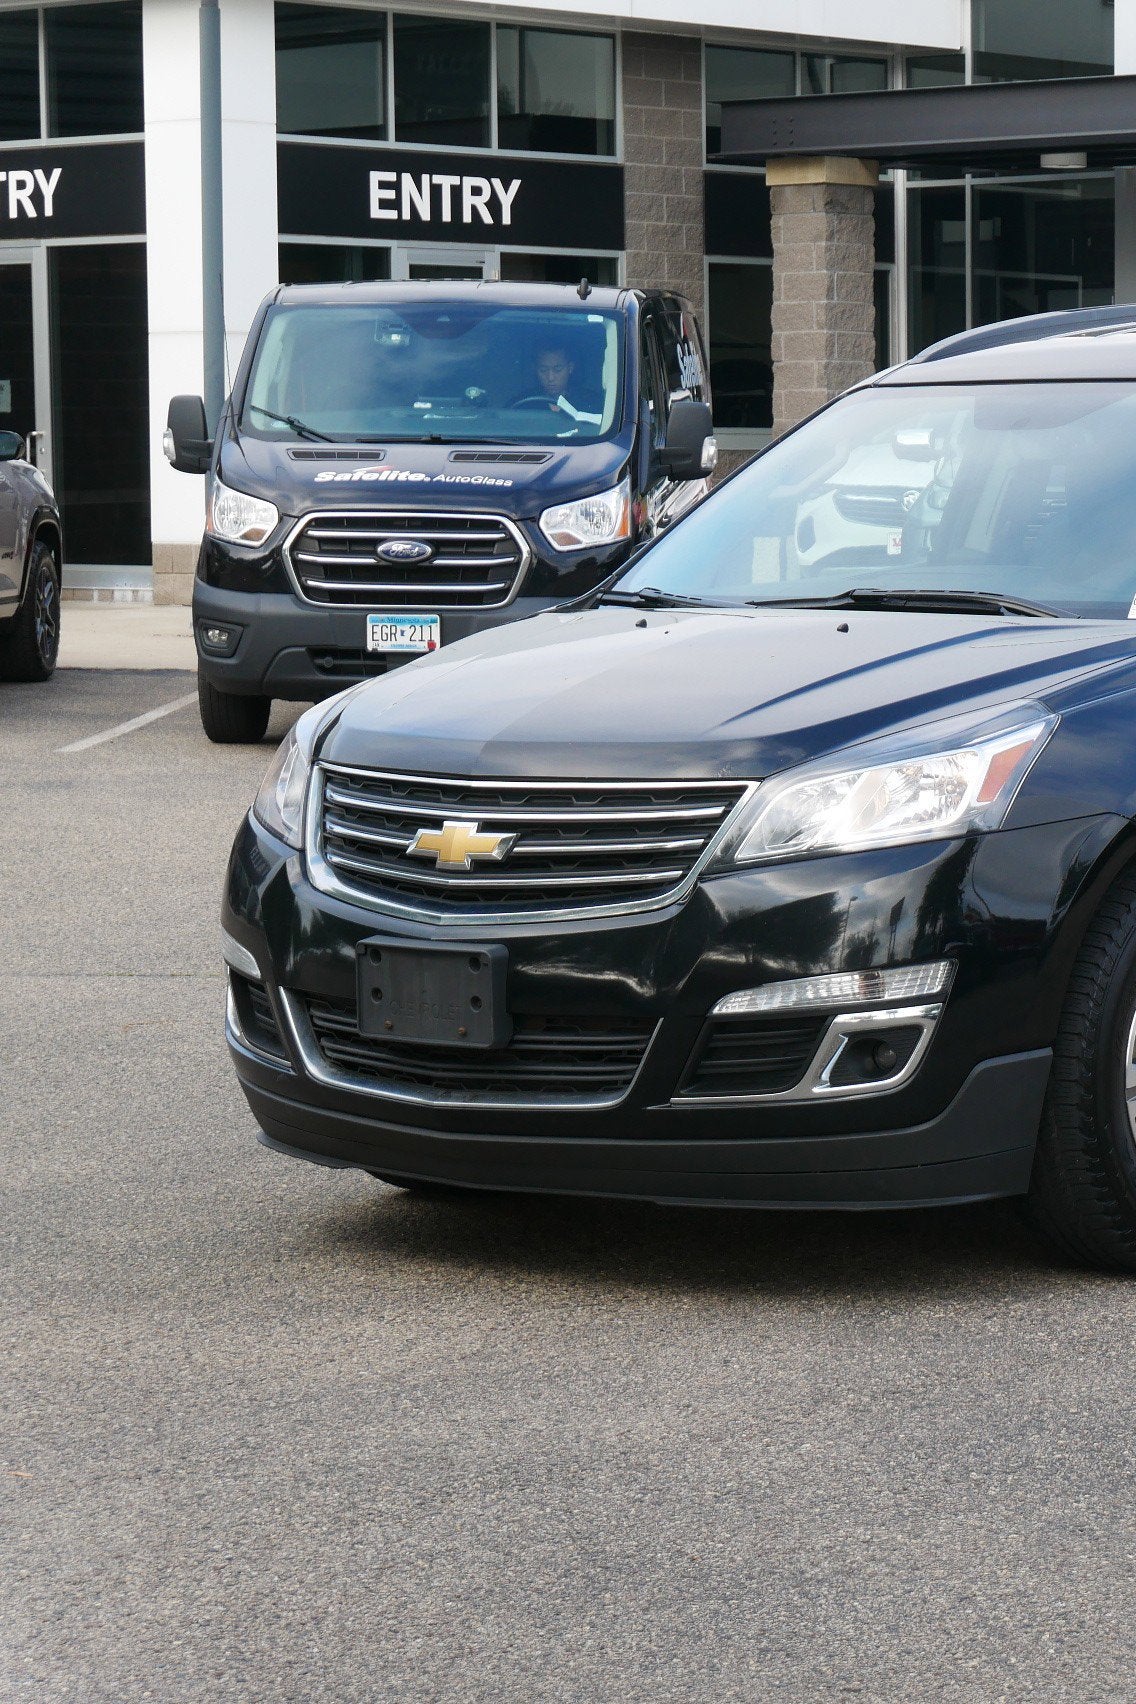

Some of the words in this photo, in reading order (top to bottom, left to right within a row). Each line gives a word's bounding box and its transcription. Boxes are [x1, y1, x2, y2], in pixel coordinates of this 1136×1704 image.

[0, 168, 62, 219] RY
[369, 170, 522, 226] ENTRY
[433, 473, 513, 487] AutoGlass
[389, 543, 419, 556] Ford
[386, 616, 420, 624] Minnesota
[371, 624, 398, 642] EGR
[409, 624, 434, 642] 211
